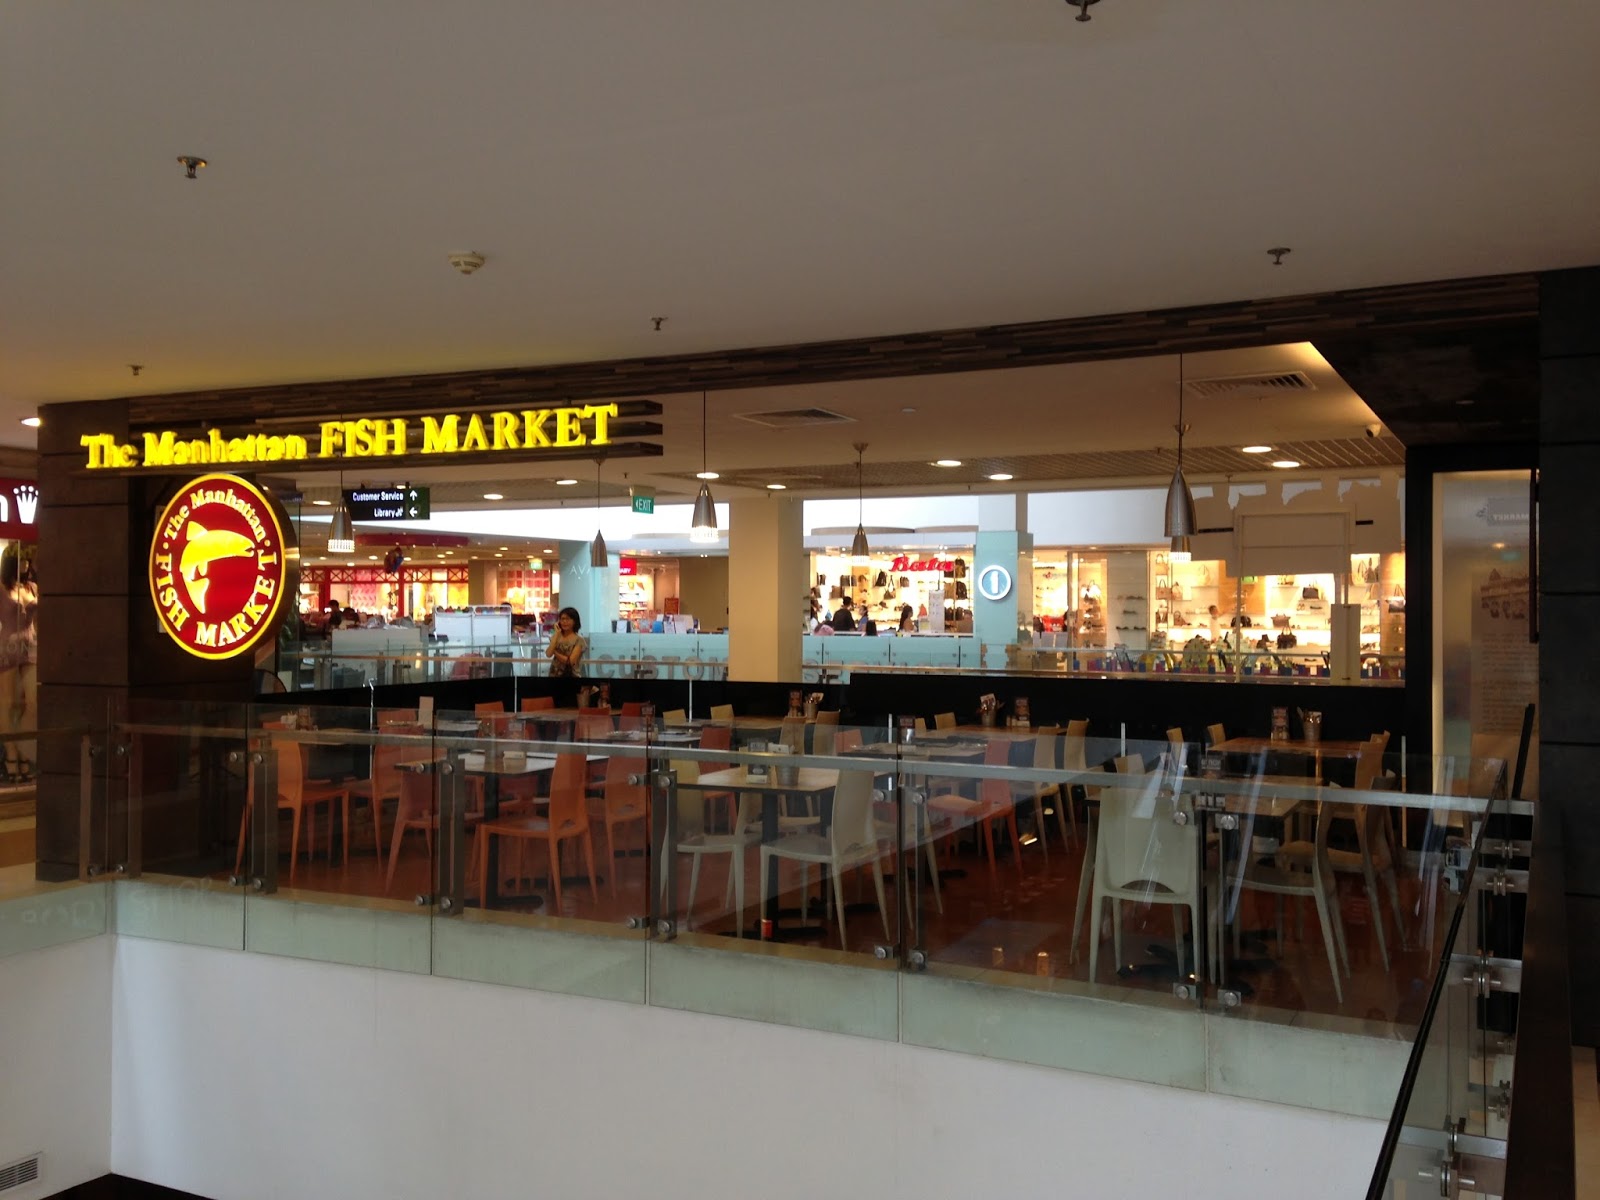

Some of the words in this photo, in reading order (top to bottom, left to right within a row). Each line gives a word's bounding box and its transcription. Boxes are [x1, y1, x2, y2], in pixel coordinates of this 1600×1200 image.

[80, 433, 138, 468] The
[142, 428, 308, 467] Manhattan
[316, 418, 410, 458] FISH
[421, 403, 618, 454] MARKET
[352, 492, 380, 501] Customer
[381, 491, 403, 500] Service
[639, 499, 652, 512] EXIT
[164, 505, 190, 541] The
[190, 488, 267, 543] Manhattan
[374, 507, 396, 518] Library
[889, 554, 955, 572] Bata
[156, 553, 190, 631] FISH
[194, 549, 277, 647] MARKET
[596, 653, 729, 680] CUSTOM
